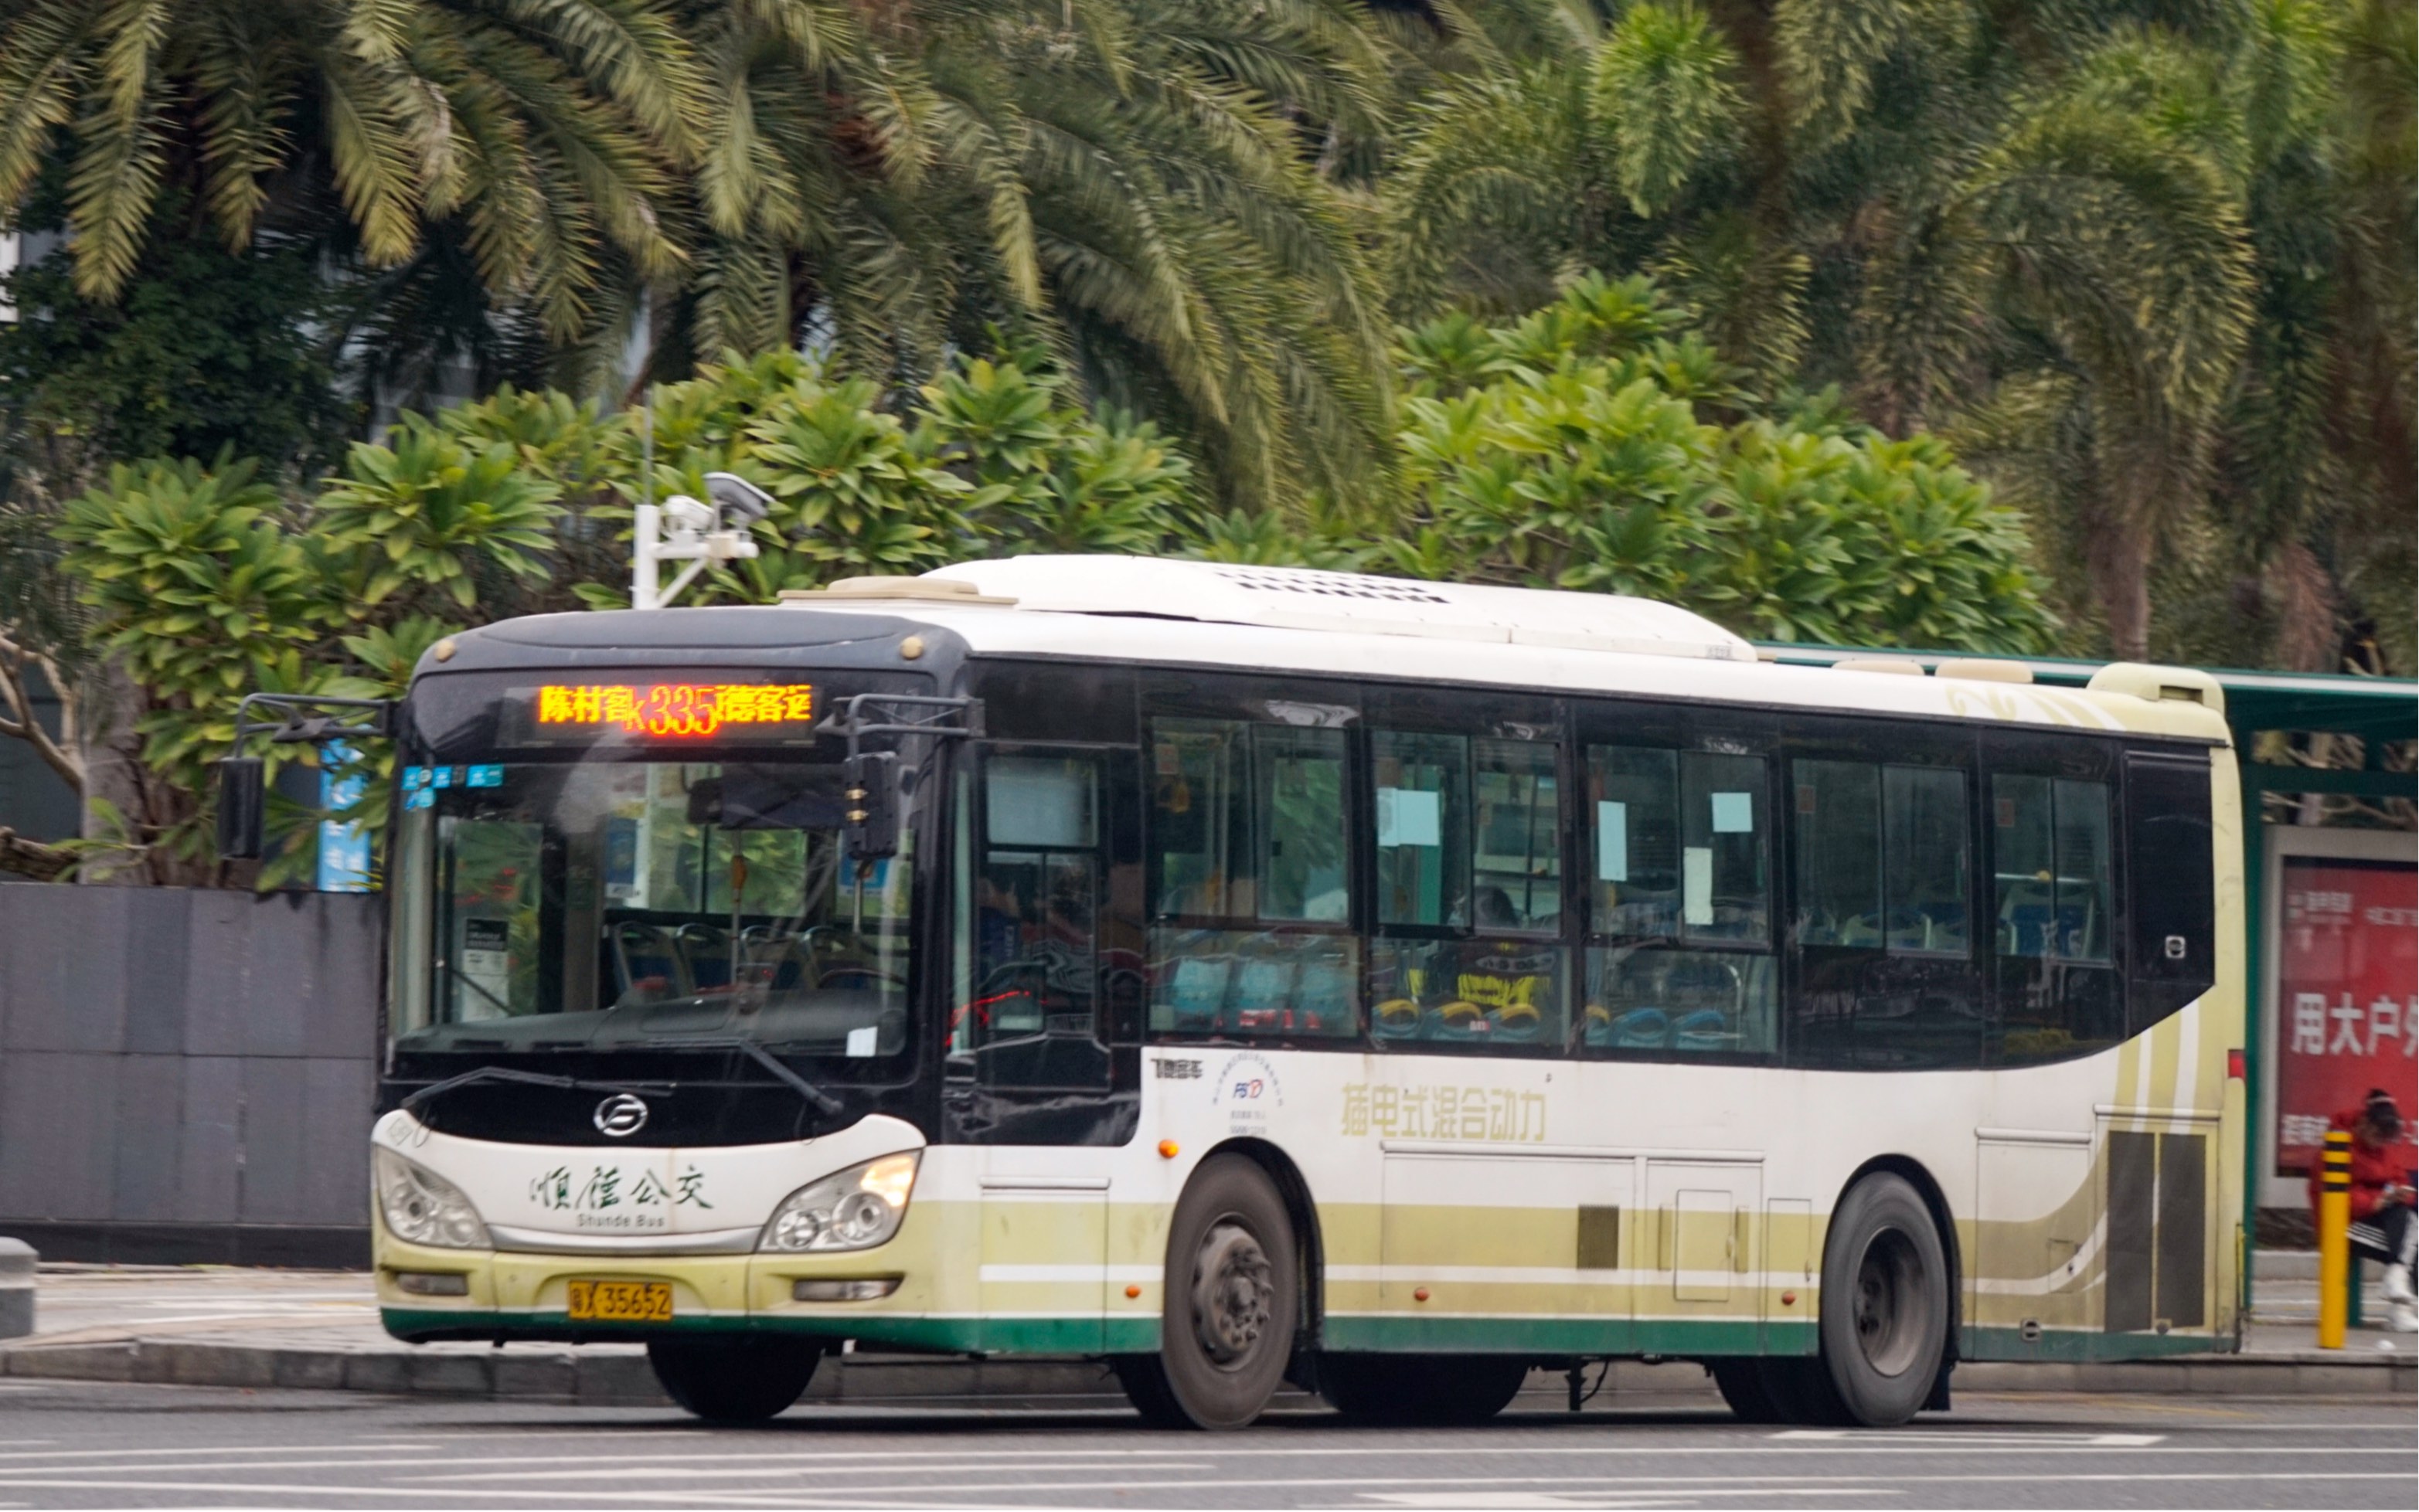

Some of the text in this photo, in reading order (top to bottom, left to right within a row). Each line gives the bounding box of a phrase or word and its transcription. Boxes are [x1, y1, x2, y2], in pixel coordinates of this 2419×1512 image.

[1342, 1082, 1546, 1141] 插电式混合动力
[577, 1214, 665, 1228] Shunde Bus
